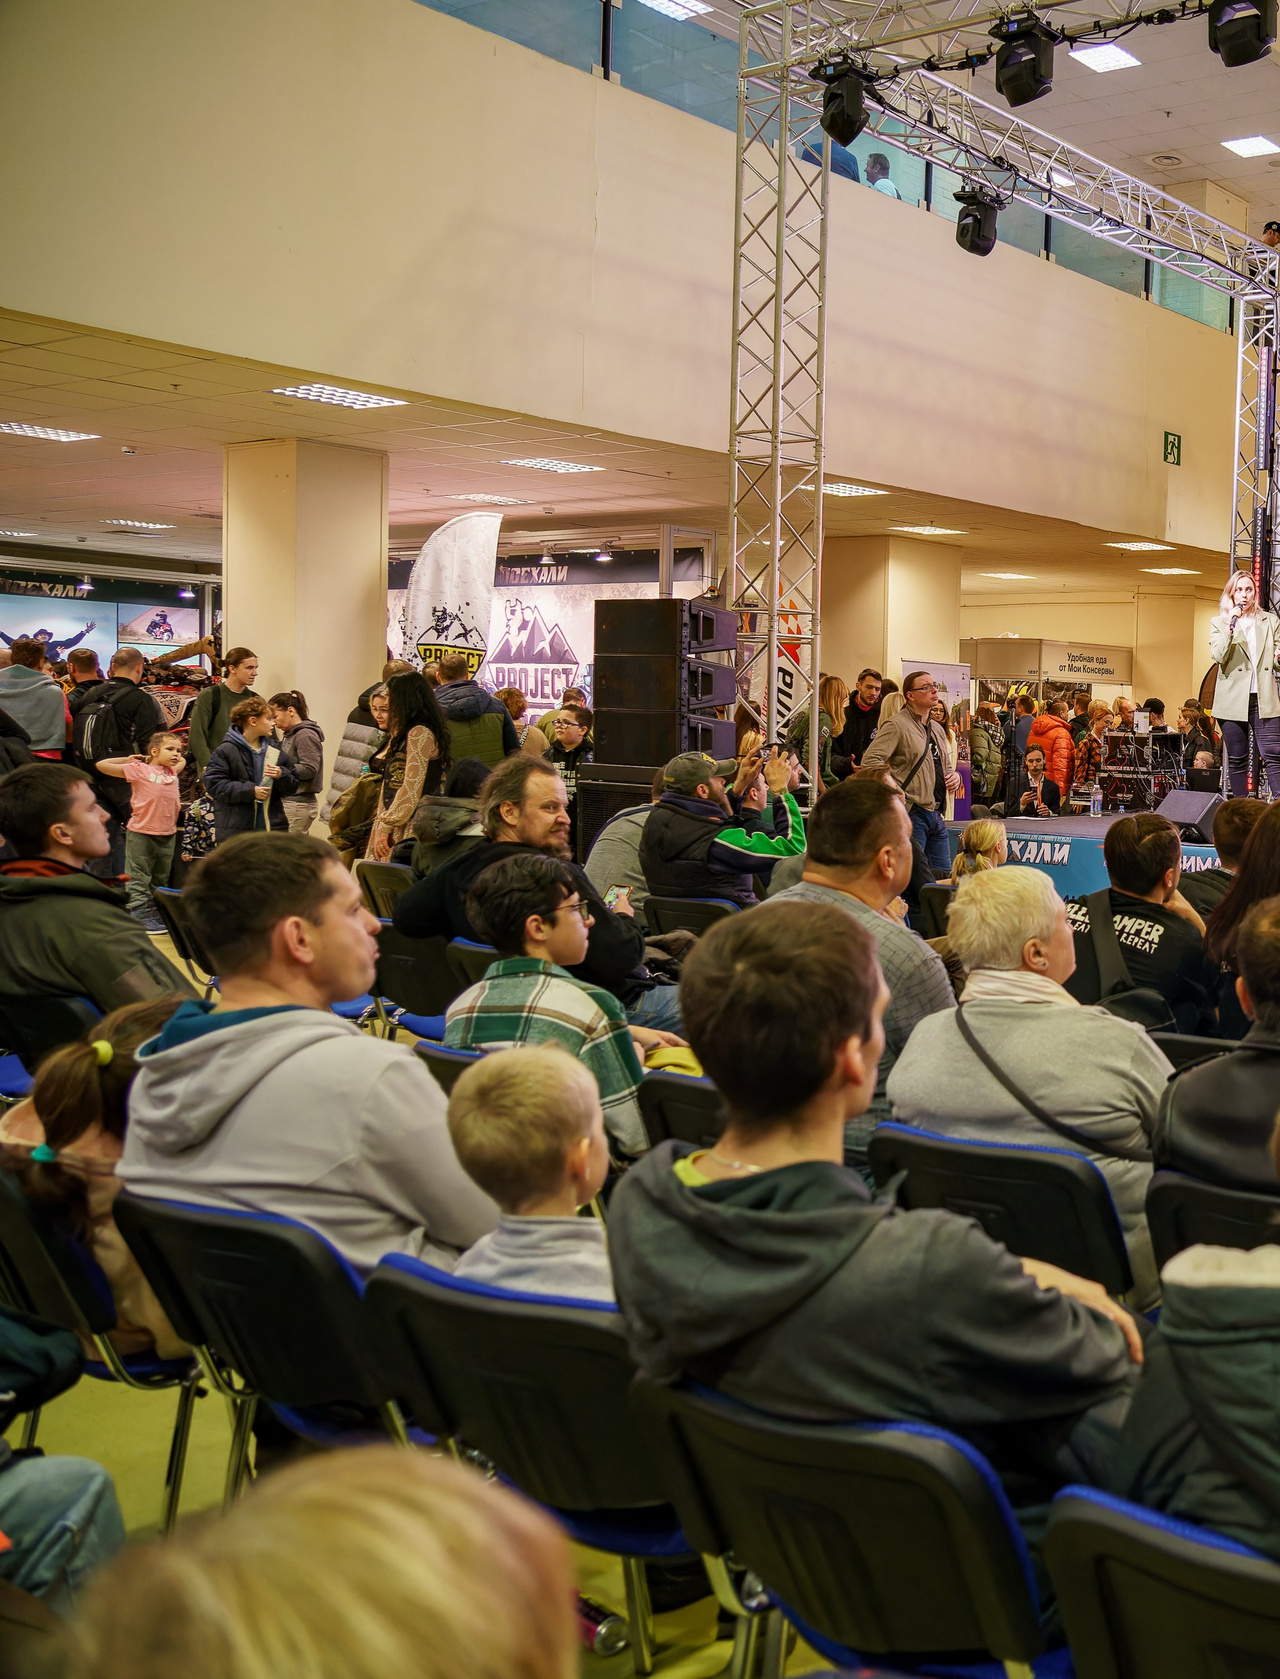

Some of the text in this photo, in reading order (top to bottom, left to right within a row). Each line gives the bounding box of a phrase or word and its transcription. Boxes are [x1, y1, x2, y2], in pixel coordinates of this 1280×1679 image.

[500, 565, 569, 584] ПОЕХАЛИ
[1067, 652, 1107, 666] Удобная еда
[1083, 664, 1115, 676] Консервы
[495, 667, 573, 700] PROJECT
[1006, 840, 1071, 866] ХАЛИ
[1119, 932, 1158, 954] REPEAT
